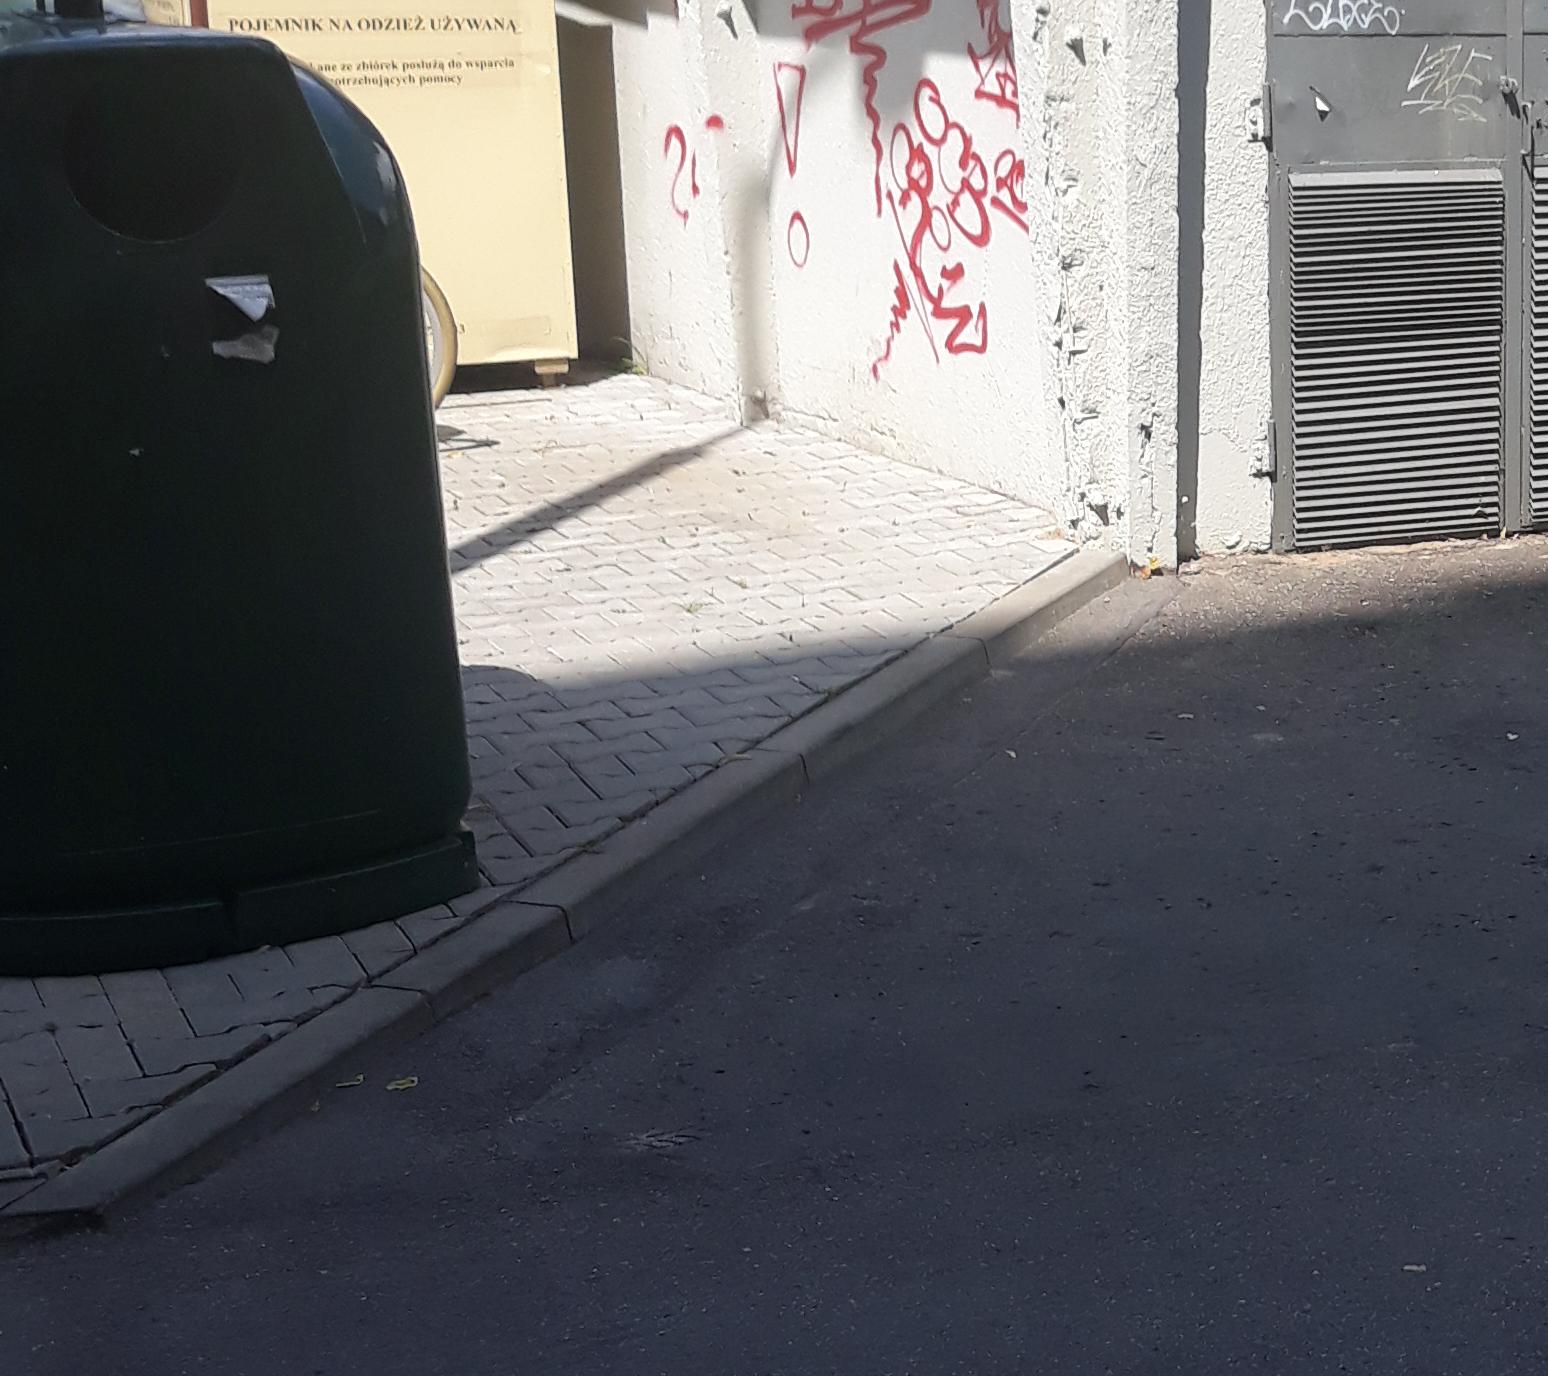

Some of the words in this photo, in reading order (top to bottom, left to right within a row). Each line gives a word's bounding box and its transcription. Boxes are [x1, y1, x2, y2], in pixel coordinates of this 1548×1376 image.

[228, 18, 323, 32] POJEMNIK
[329, 18, 353, 32] NA
[357, 15, 425, 32] ODZIEŻ
[430, 15, 521, 35] UŻYWANĄ
[356, 60, 397, 71] zbiórek
[448, 58, 462, 69] do
[465, 58, 515, 71] wsparcia
[419, 73, 462, 87] pomocy
